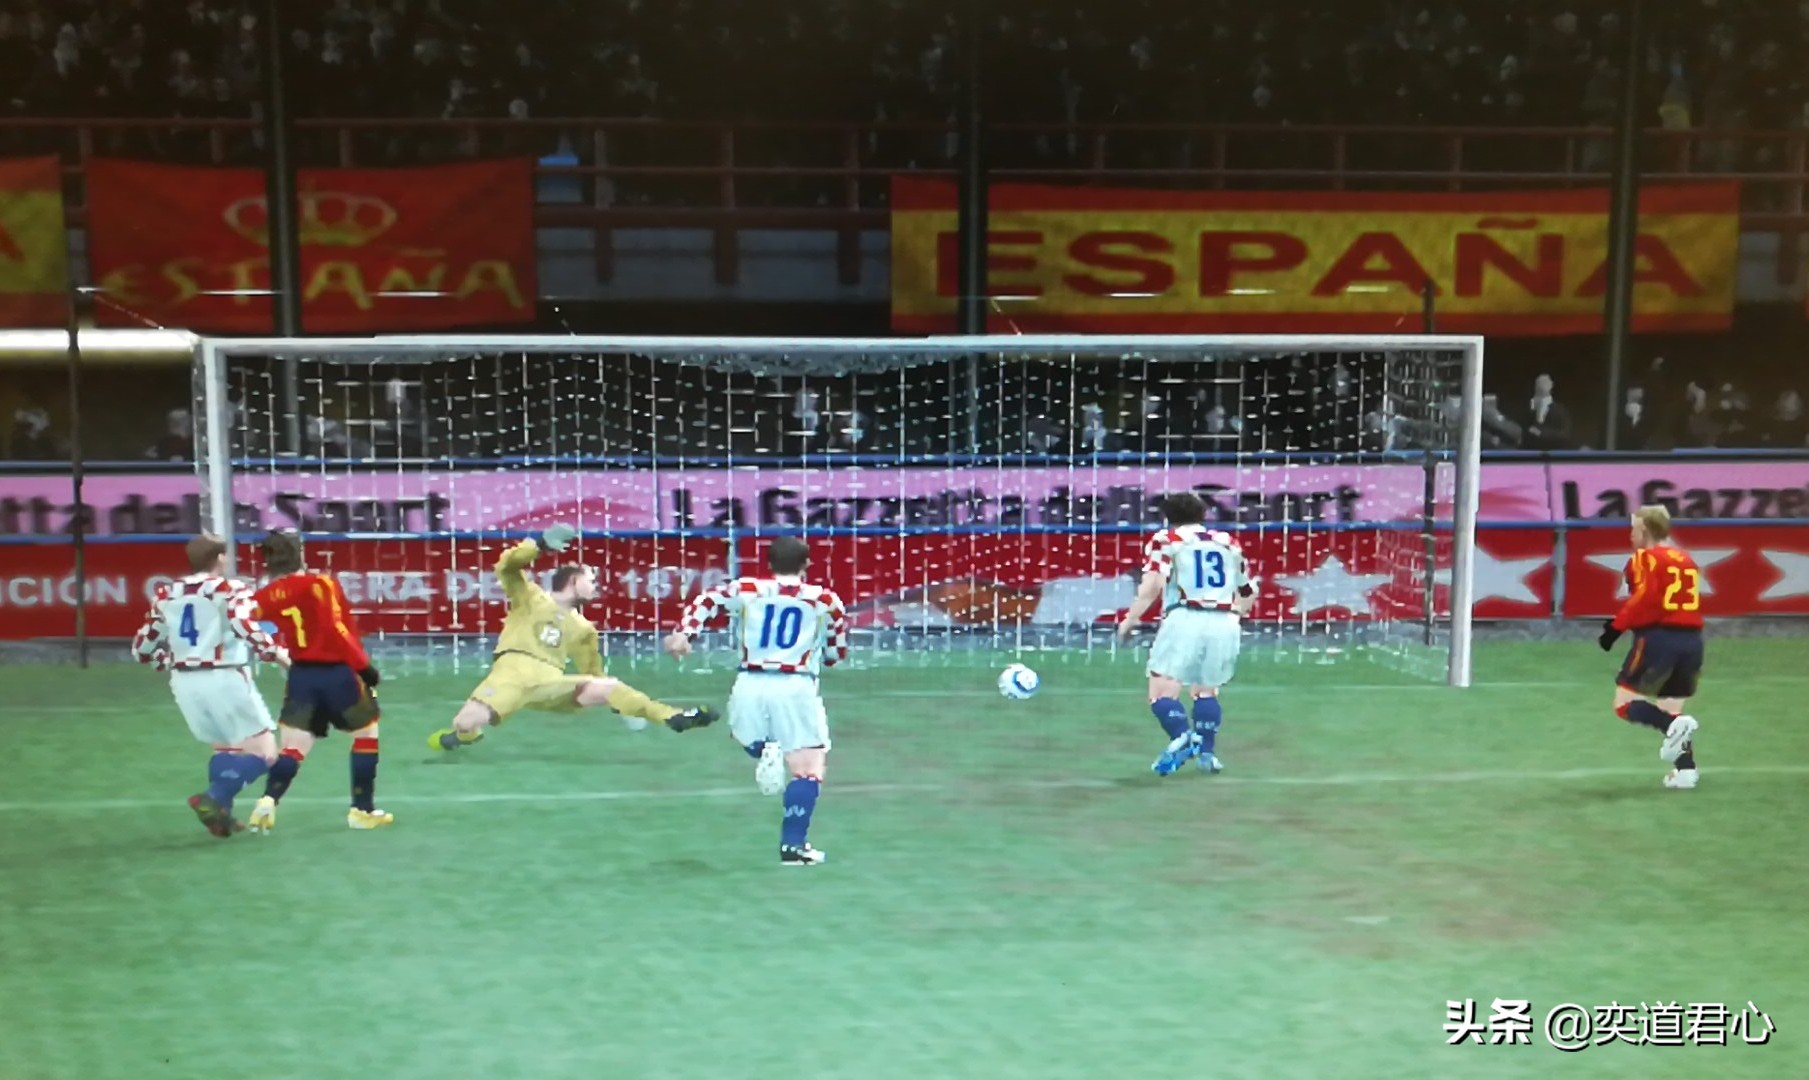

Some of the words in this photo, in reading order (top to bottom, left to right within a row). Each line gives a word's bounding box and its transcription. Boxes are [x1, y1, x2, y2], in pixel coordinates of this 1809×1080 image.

[937, 217, 1707, 299] ESPAÑA
[1640, 479, 1809, 519] Gazze
[0, 567, 128, 606] CIÓN
[1193, 549, 1227, 589] 13
[1663, 565, 1700, 611] 23
[179, 603, 199, 646] 4
[281, 605, 308, 648] 7
[759, 603, 801, 650] 10
